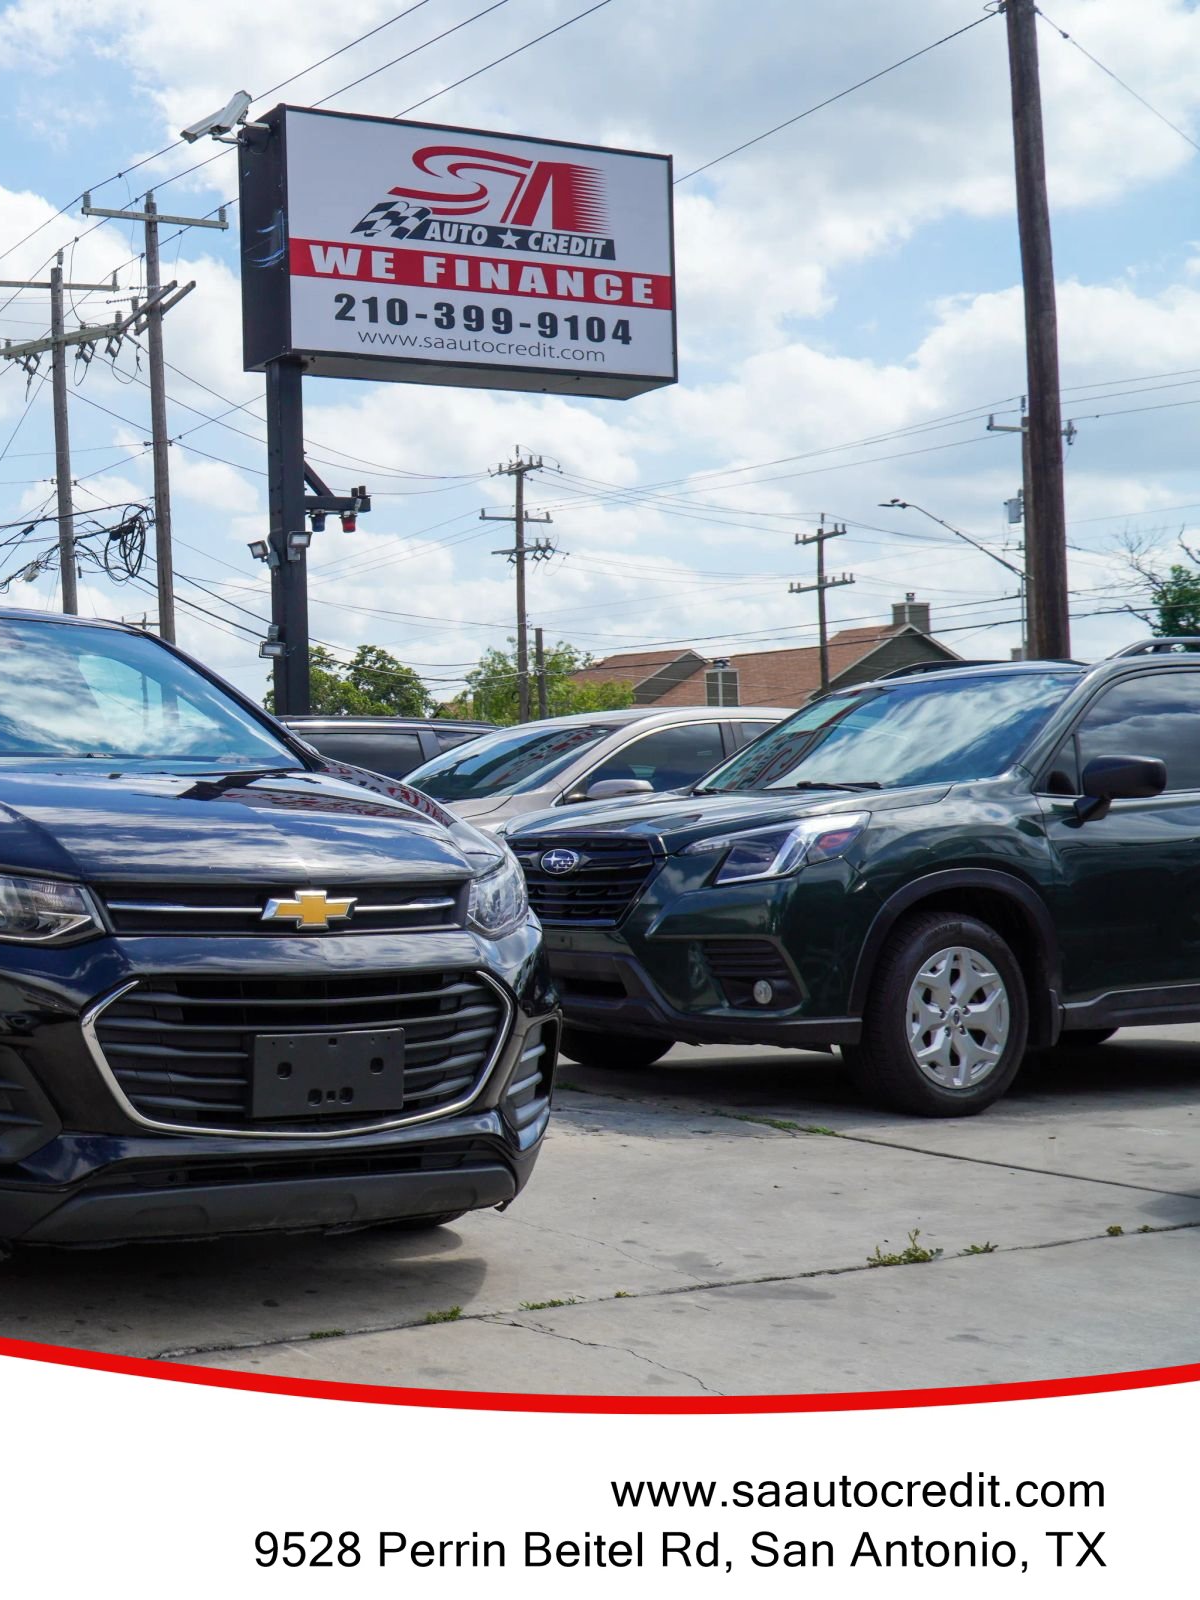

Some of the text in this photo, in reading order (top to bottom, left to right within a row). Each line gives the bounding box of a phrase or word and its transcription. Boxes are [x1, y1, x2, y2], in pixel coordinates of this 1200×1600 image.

[387, 145, 611, 235] SA
[423, 221, 607, 258] AUTO CREDIT
[308, 244, 654, 304] WE FINANCE
[333, 292, 633, 345] 210-399-9104
[357, 330, 606, 363] www.saautocredit.com
